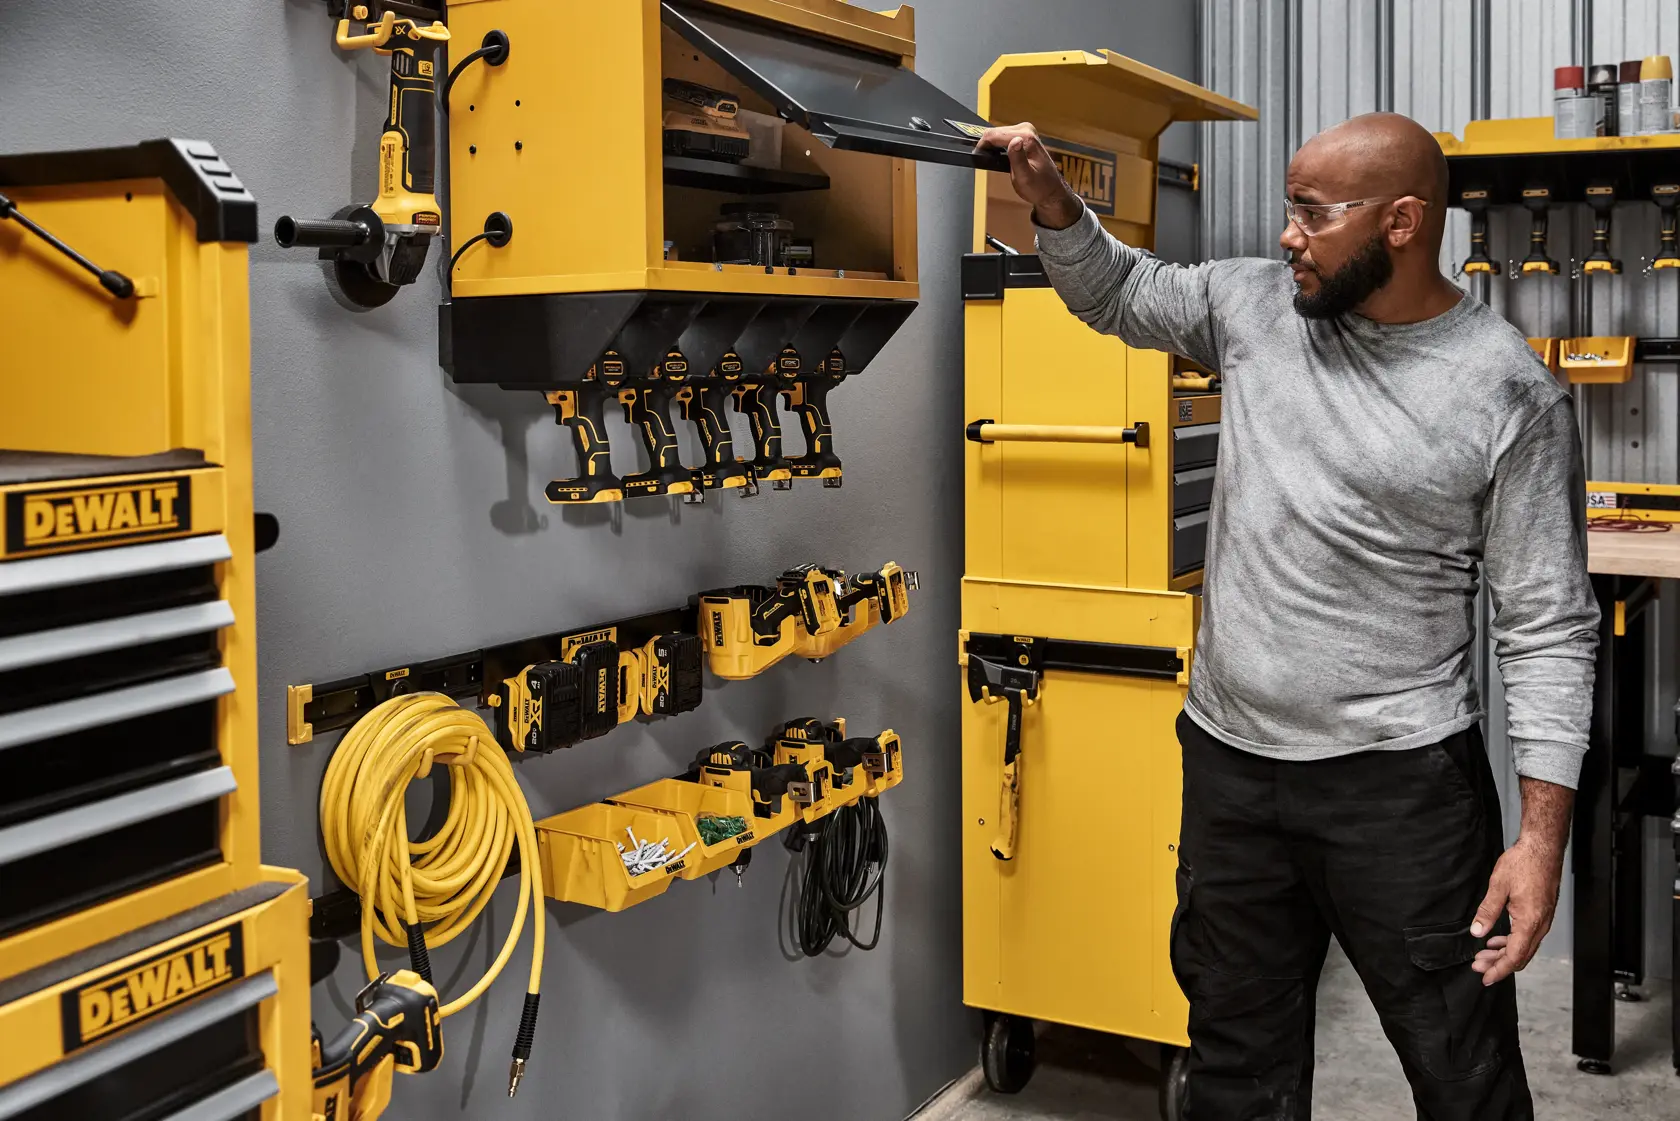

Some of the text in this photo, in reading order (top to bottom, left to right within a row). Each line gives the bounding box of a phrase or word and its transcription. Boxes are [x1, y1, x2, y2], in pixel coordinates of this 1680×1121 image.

[1058, 154, 1113, 202] WALT
[24, 484, 179, 542] DEWALT
[713, 611, 724, 647] DEWALT
[531, 680, 538, 689] 4
[598, 668, 607, 714] DEWALT
[657, 662, 670, 696] XR
[530, 695, 543, 732] XR
[735, 831, 755, 845] DEWALT
[665, 859, 686, 875] DEWALT
[80, 936, 233, 1038] DEWALT
